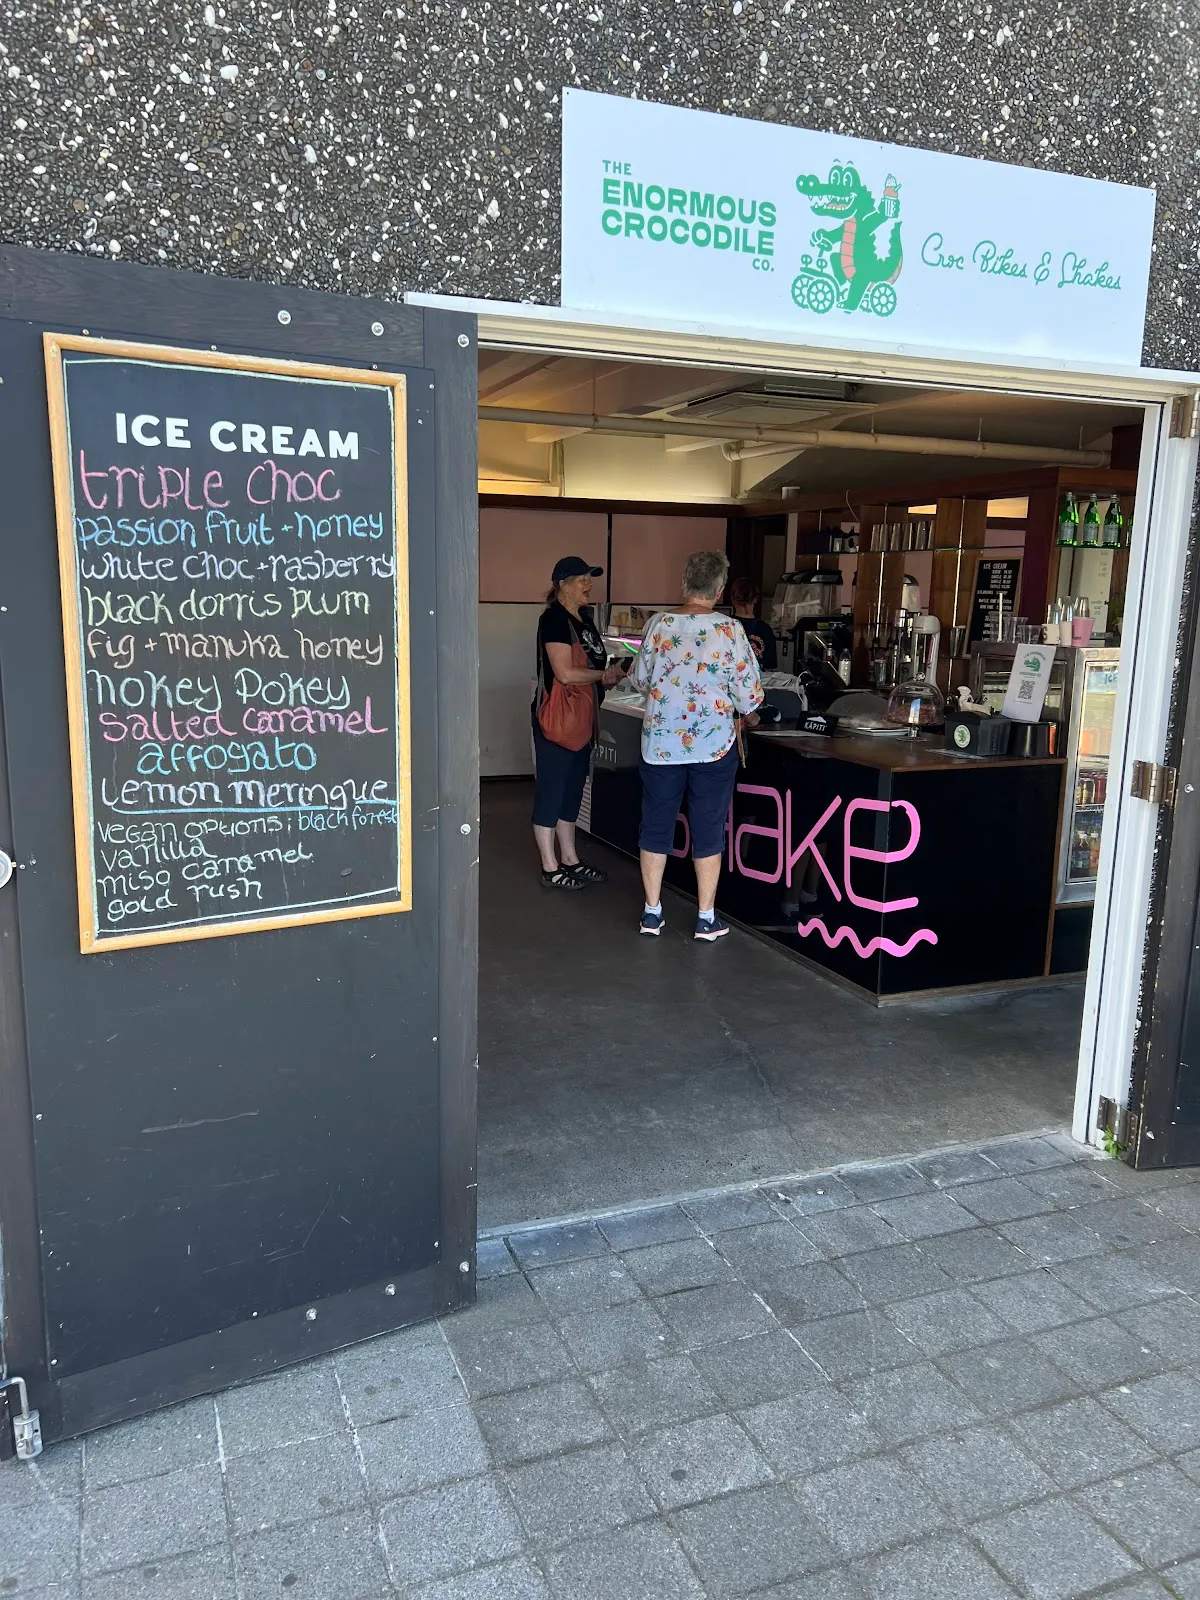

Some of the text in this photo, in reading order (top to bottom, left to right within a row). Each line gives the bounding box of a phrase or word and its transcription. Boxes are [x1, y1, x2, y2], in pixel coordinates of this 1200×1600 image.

[602, 159, 632, 176] THE
[601, 177, 778, 227] ENORMOUS
[601, 208, 775, 257] CROCODILE
[752, 257, 776, 273] CO.
[920, 232, 1122, 291] Croc Bikes & Shakes
[115, 412, 359, 460] ICE CREAM
[247, 460, 342, 505] choc
[75, 515, 197, 550] passion
[205, 510, 275, 546] fruit
[81, 552, 178, 582] white
[183, 551, 255, 581] choc
[84, 586, 174, 627] black
[160, 630, 289, 661] manuka
[294, 628, 384, 665] honey
[136, 736, 318, 775] affogato
[298, 810, 348, 832] black
[351, 806, 399, 832] forest
[100, 836, 217, 872] vanilla
[673, 783, 921, 913] ake
[98, 868, 170, 898] miso
[106, 878, 263, 923] gold rush
